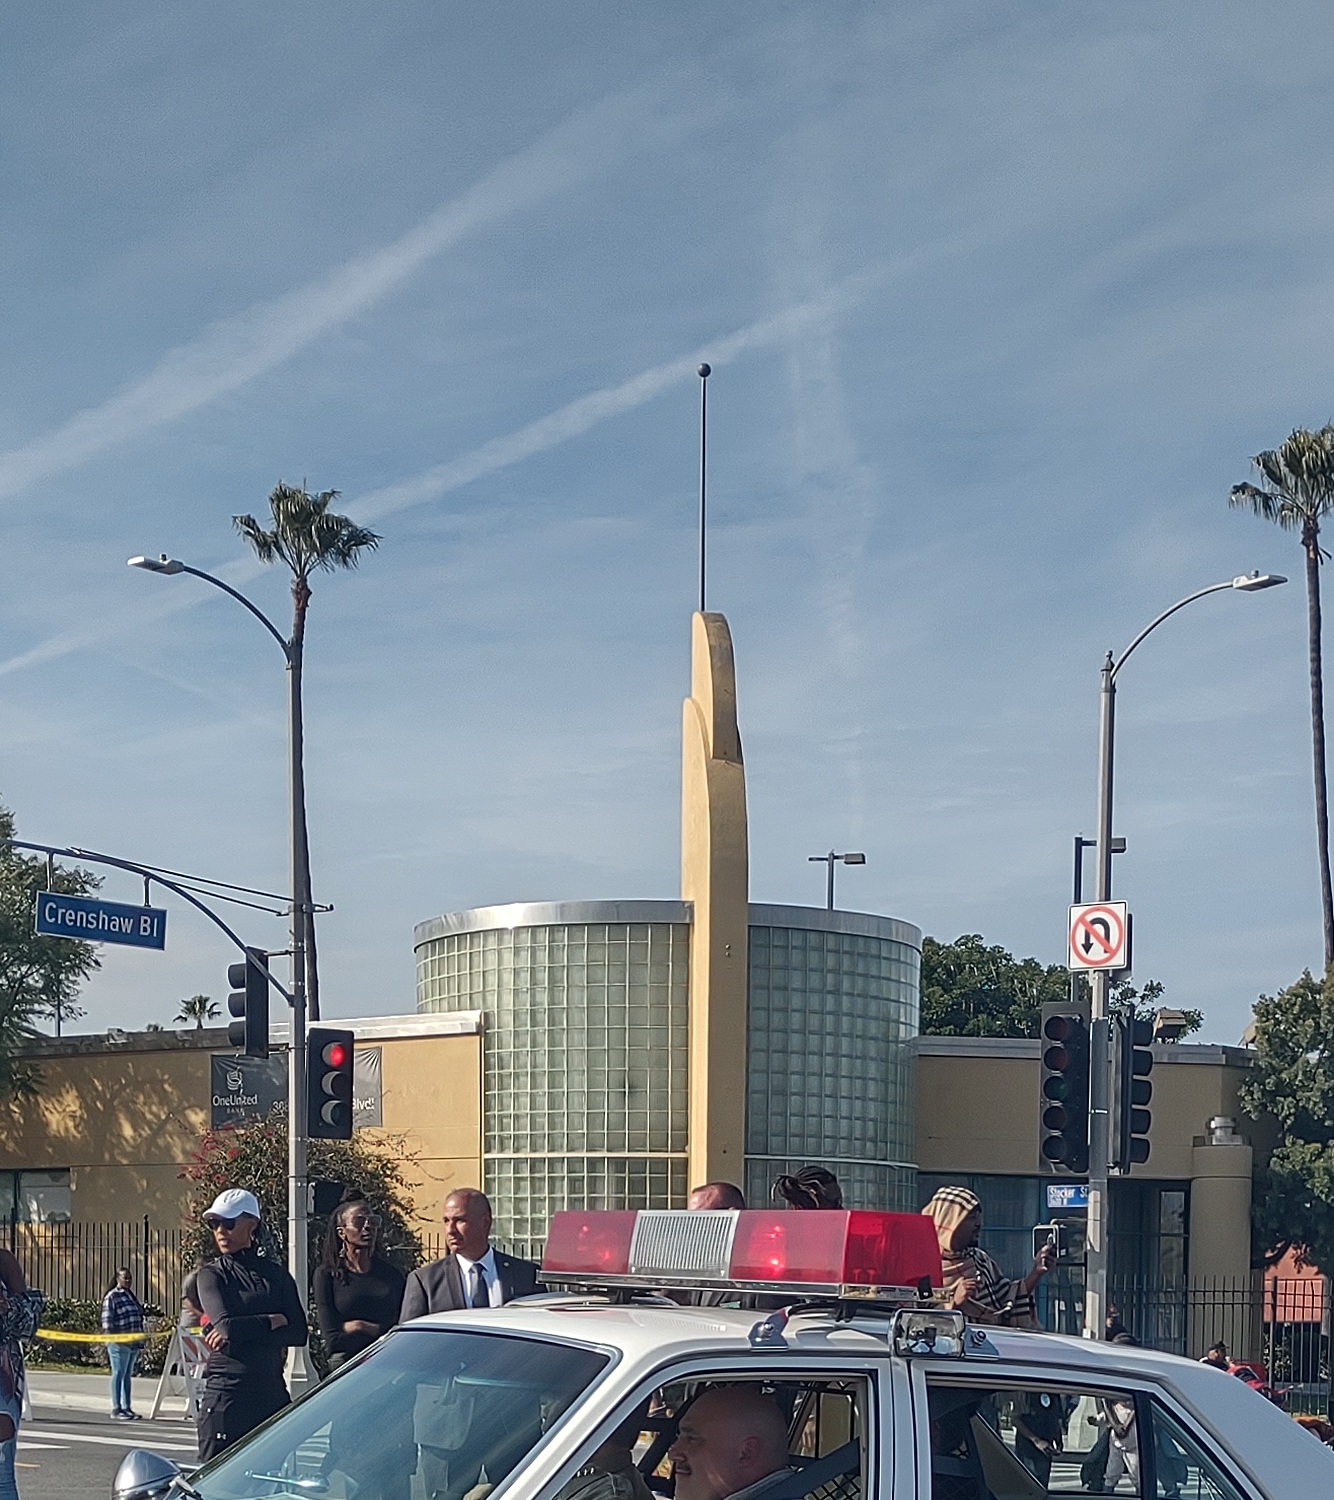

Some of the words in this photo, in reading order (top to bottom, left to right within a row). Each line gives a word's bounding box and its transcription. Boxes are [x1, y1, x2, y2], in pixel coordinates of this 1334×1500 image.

[45, 902, 133, 934] Crenshaw
[139, 916, 158, 938] Bl
[212, 1094, 258, 1107] OneUnited
[1050, 1187, 1076, 1199] Stocker
